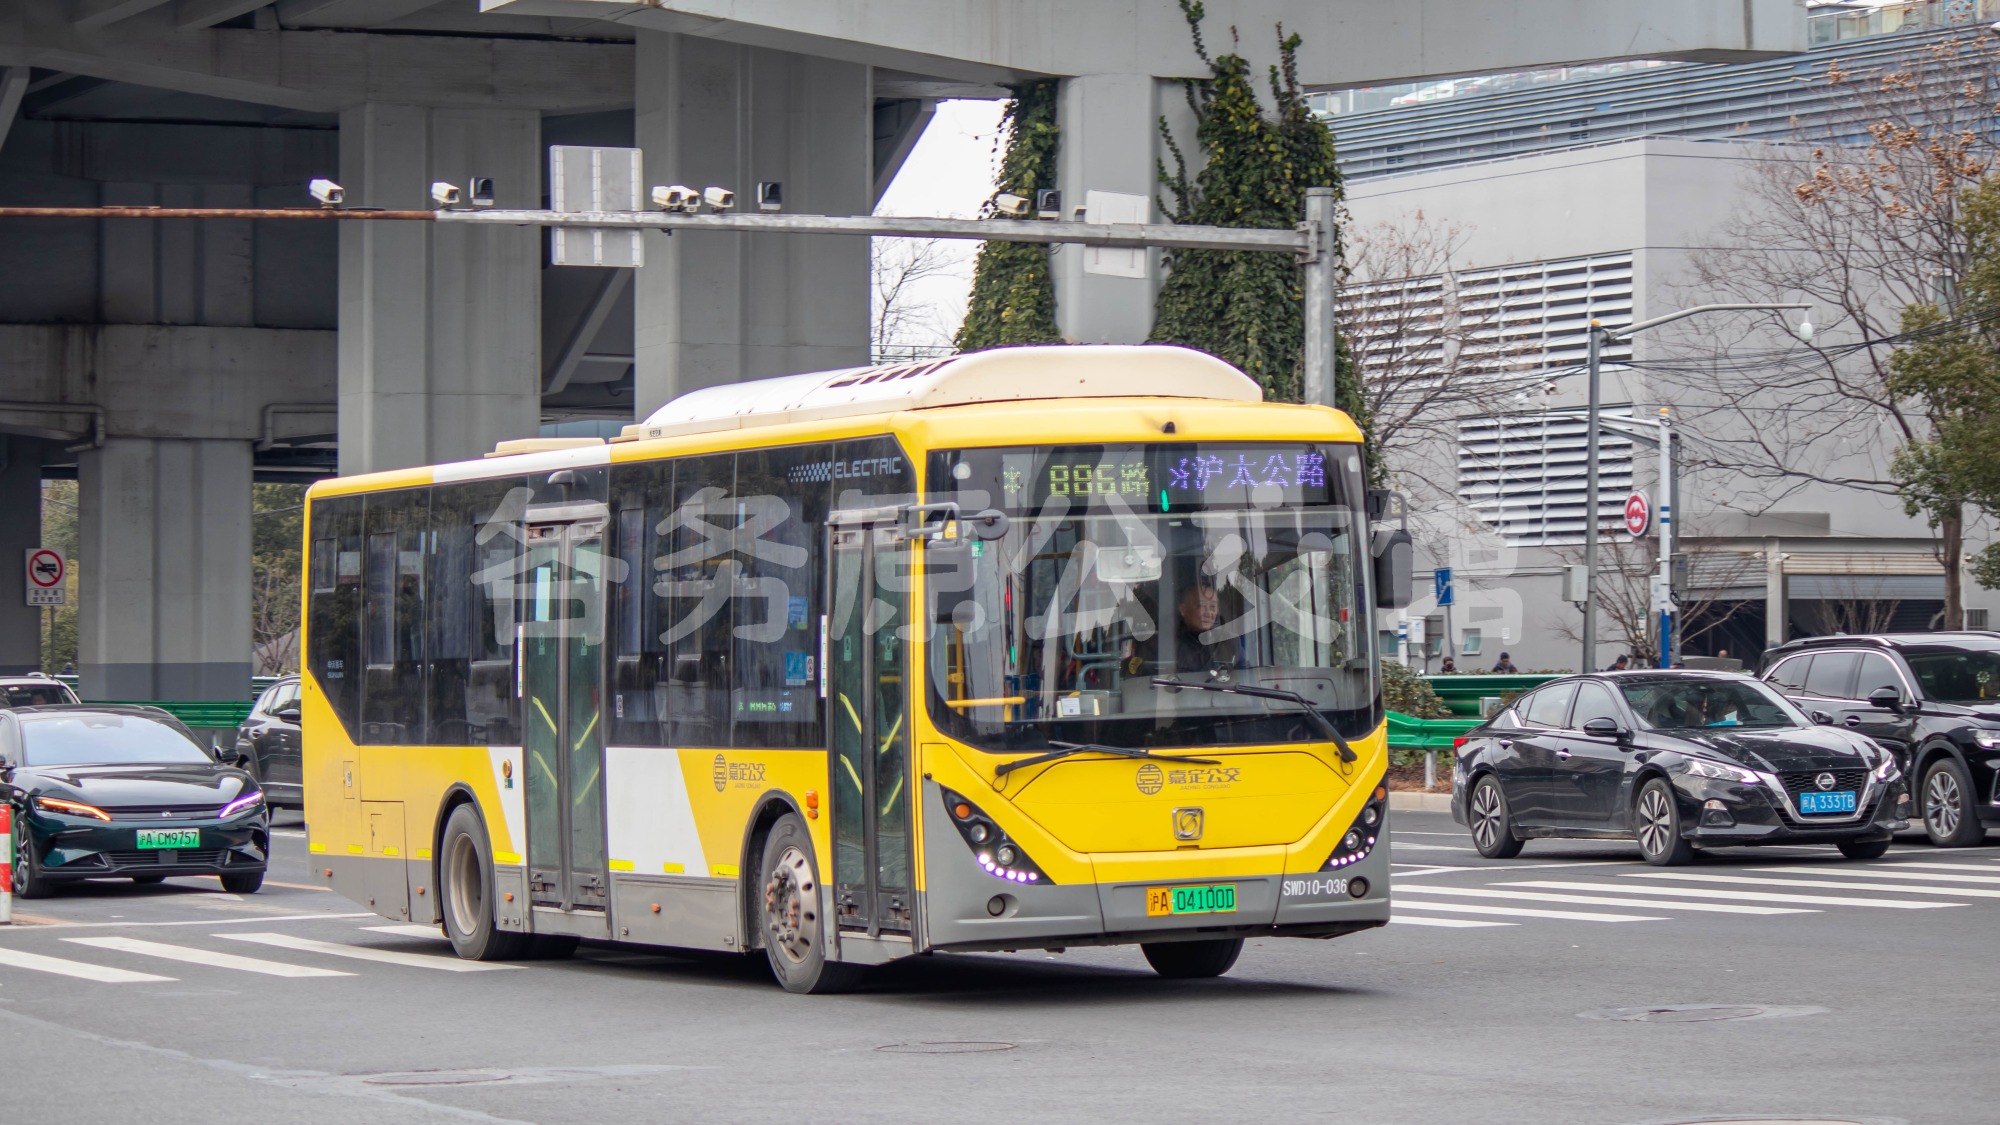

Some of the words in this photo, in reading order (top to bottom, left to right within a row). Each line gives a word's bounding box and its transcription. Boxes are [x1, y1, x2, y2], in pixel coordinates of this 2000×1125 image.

[835, 456, 902, 479] ELECTRIC
[728, 762, 767, 782] 嘉定公交
[1168, 767, 1242, 785] 嘉定公交
[1283, 878, 1348, 896] SWD10-036
